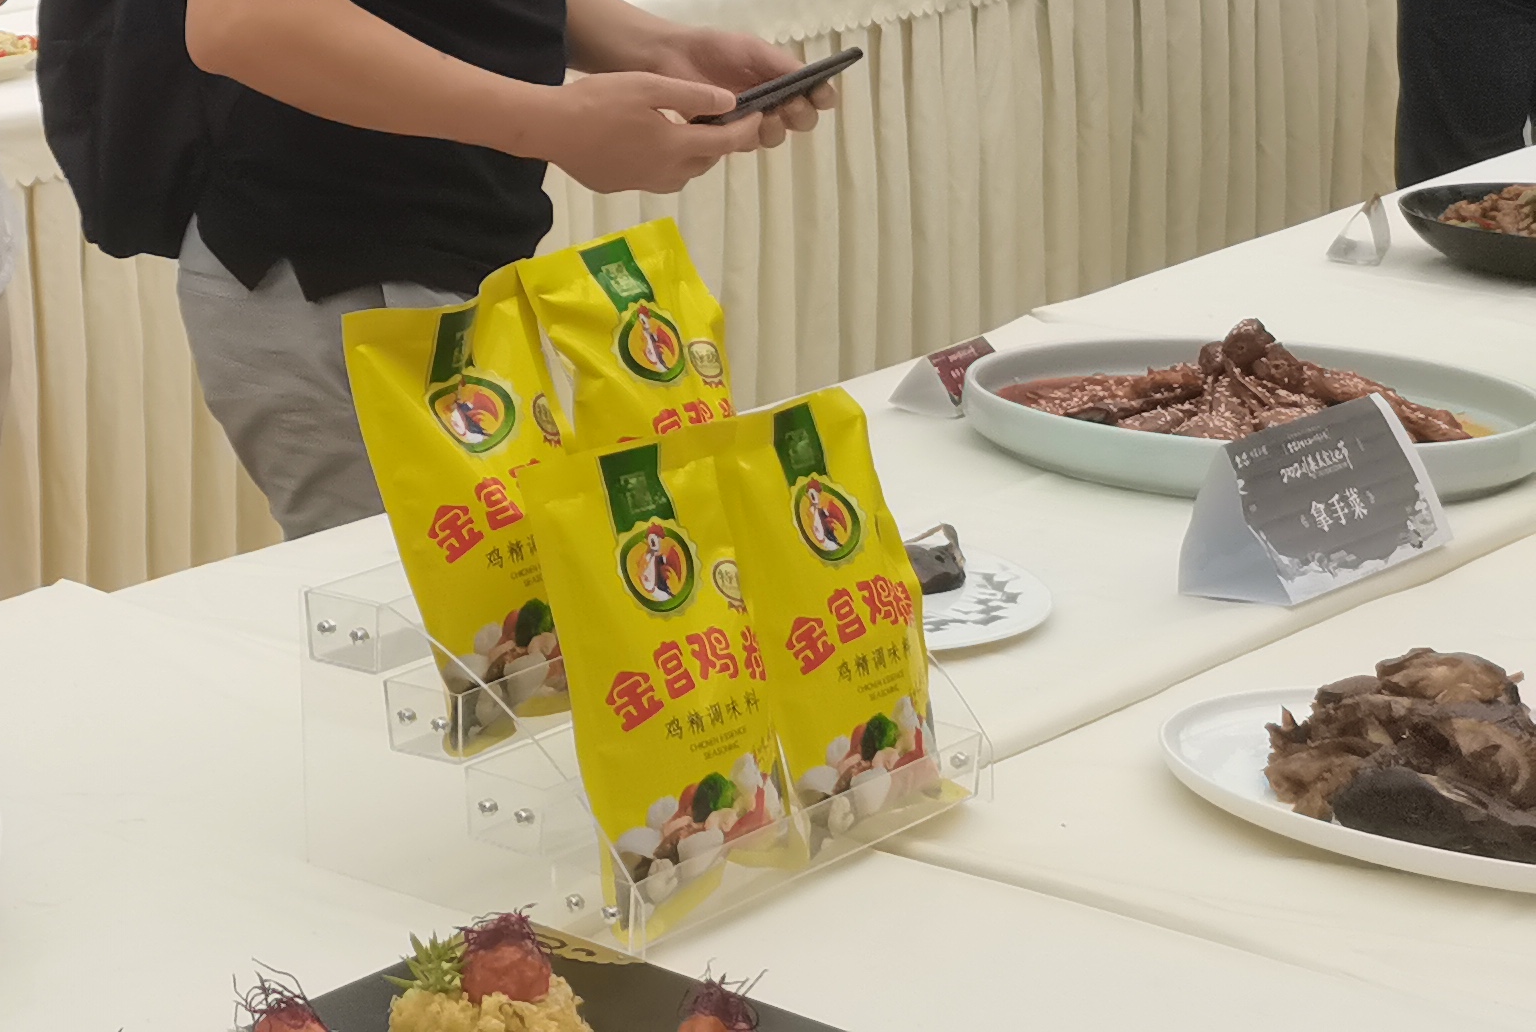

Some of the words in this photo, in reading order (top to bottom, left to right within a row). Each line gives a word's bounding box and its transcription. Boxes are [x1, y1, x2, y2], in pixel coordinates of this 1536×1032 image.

[427, 462, 534, 564] 金宫
[1310, 486, 1368, 533] 拿手菜
[665, 687, 760, 741] 鸡精调味料
